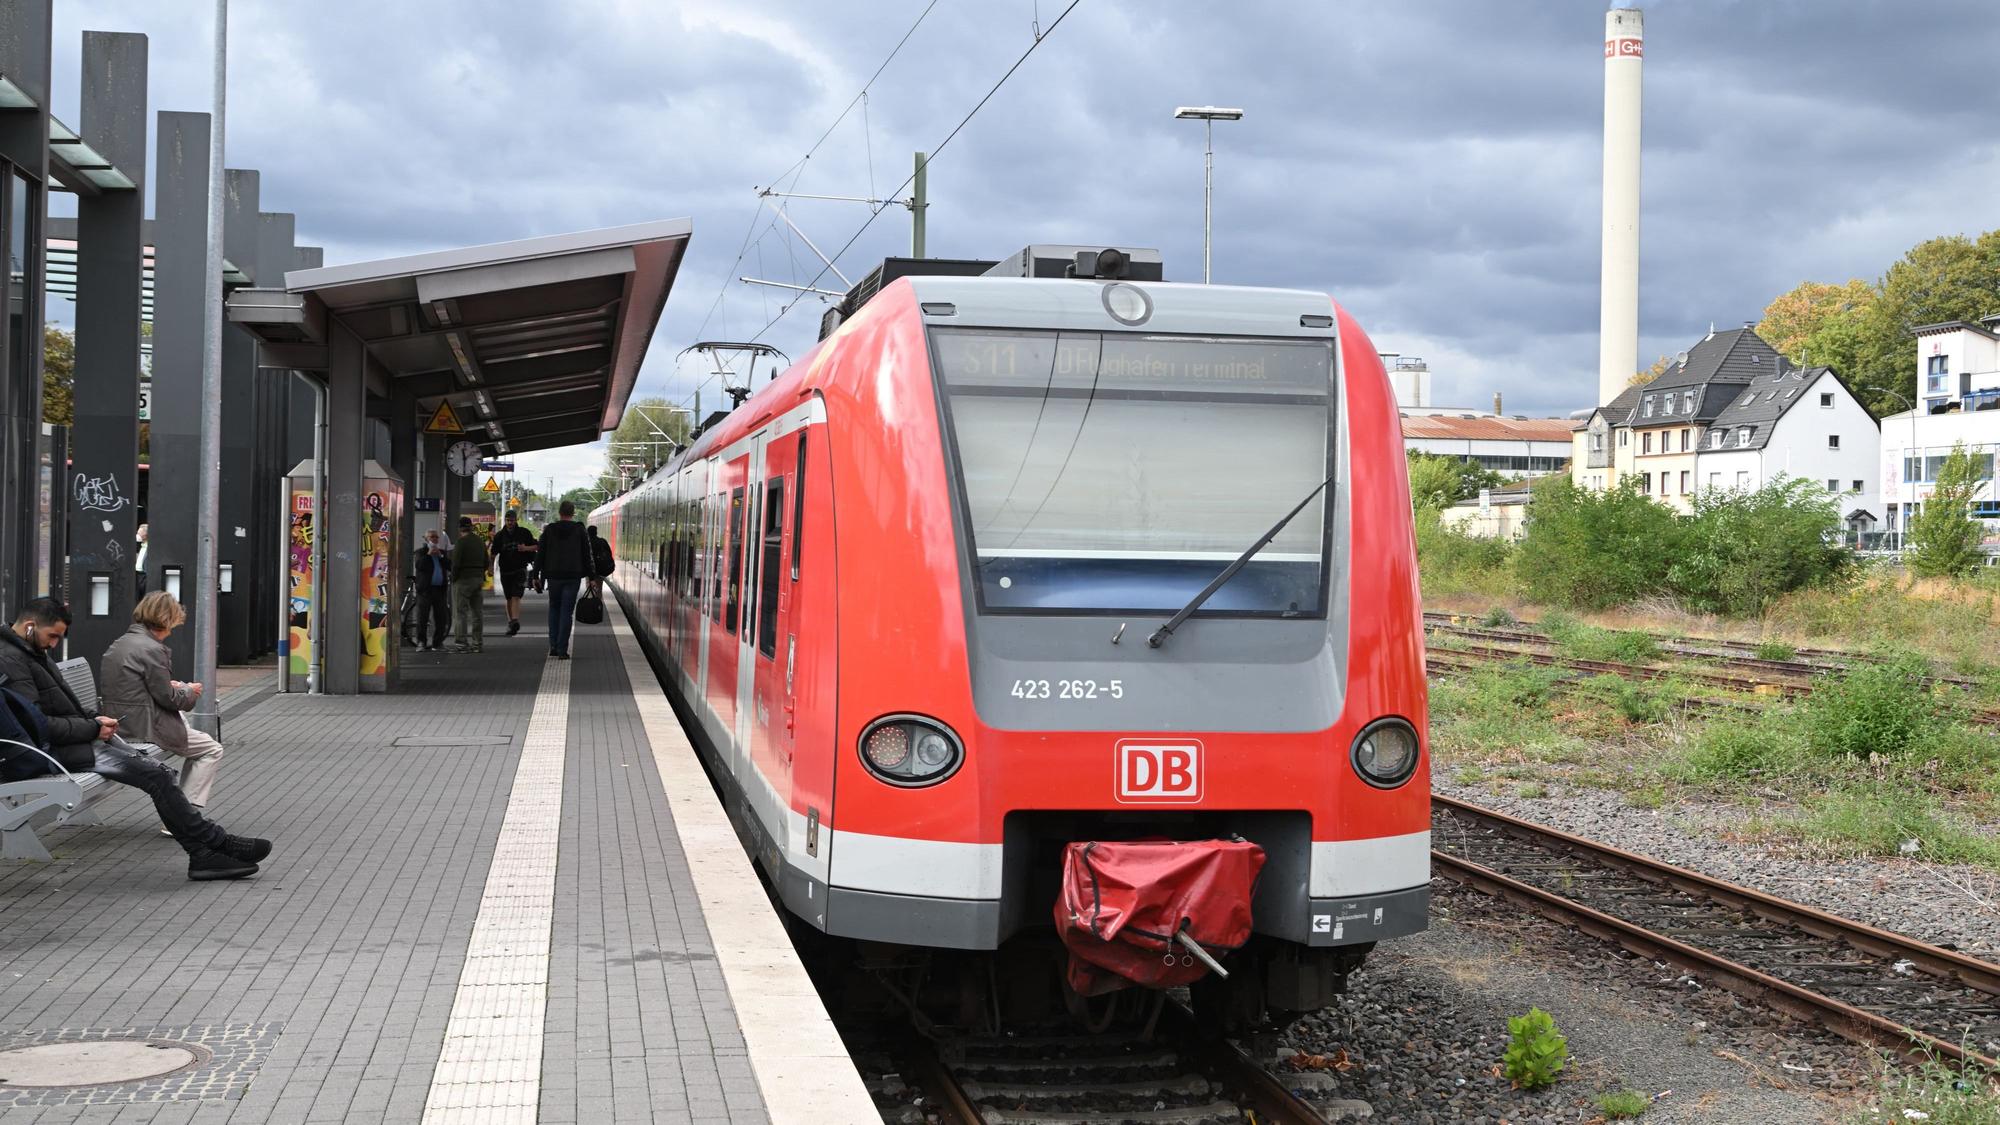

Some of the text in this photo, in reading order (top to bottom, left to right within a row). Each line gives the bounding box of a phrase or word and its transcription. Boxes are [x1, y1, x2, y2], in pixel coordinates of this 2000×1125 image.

[963, 342, 1017, 376] S11
[1011, 679, 1123, 699] 423 262-5
[1126, 749, 1193, 793] DB
